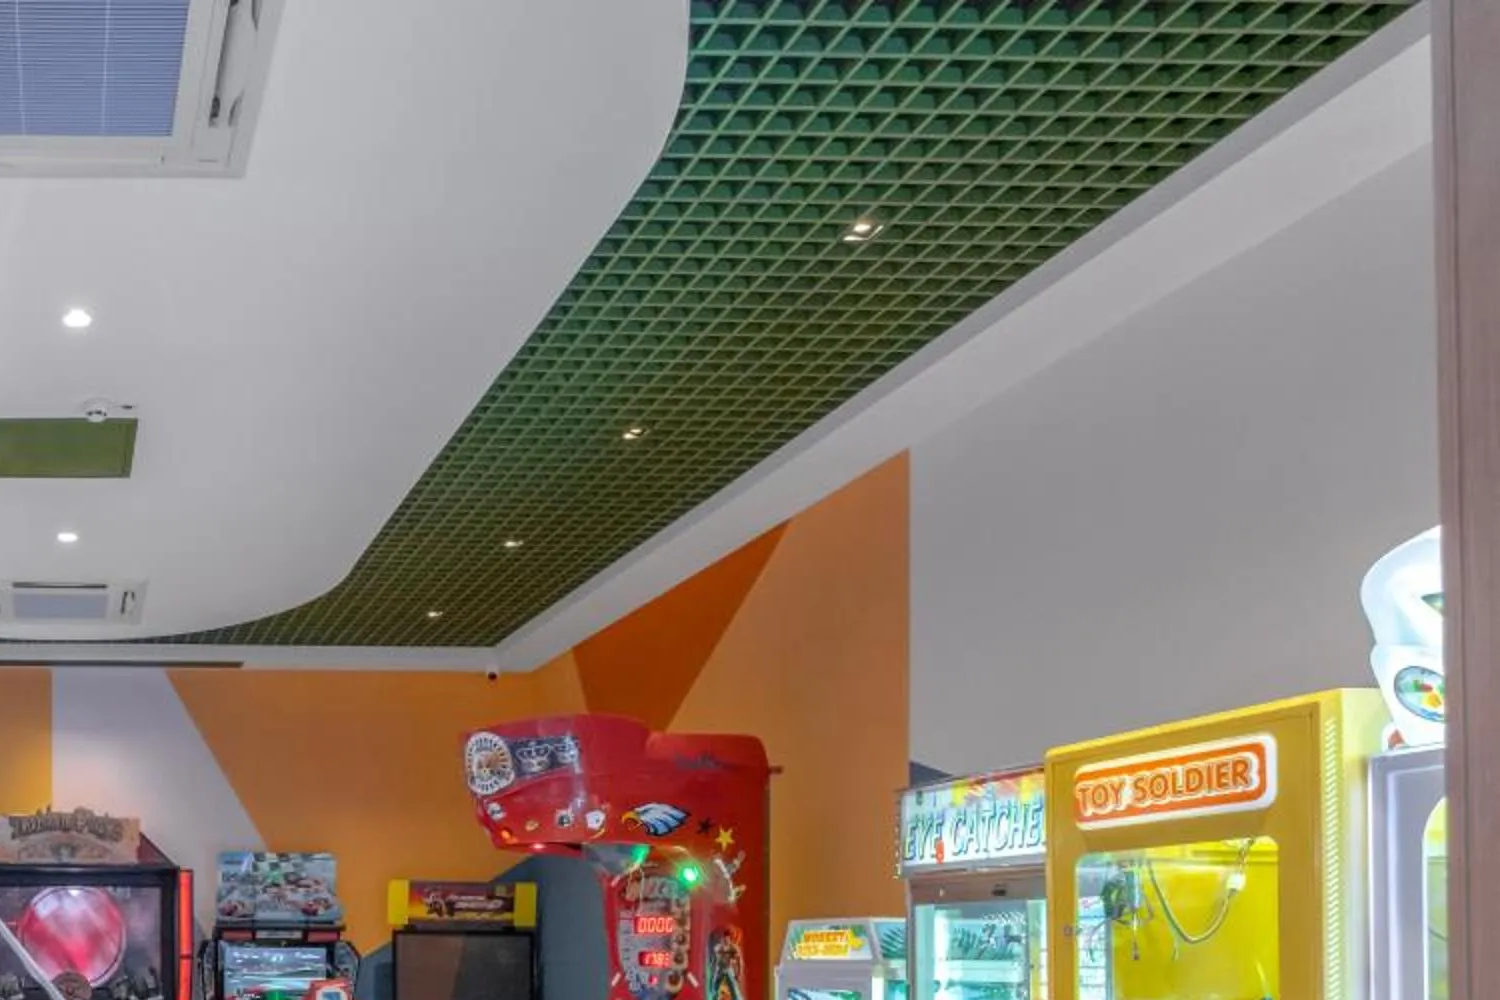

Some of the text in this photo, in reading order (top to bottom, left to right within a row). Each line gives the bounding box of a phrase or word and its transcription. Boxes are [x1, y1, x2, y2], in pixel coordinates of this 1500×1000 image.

[1078, 759, 1250, 814] TOY SOLDIER
[904, 795, 1046, 860] EYE CATCHE
